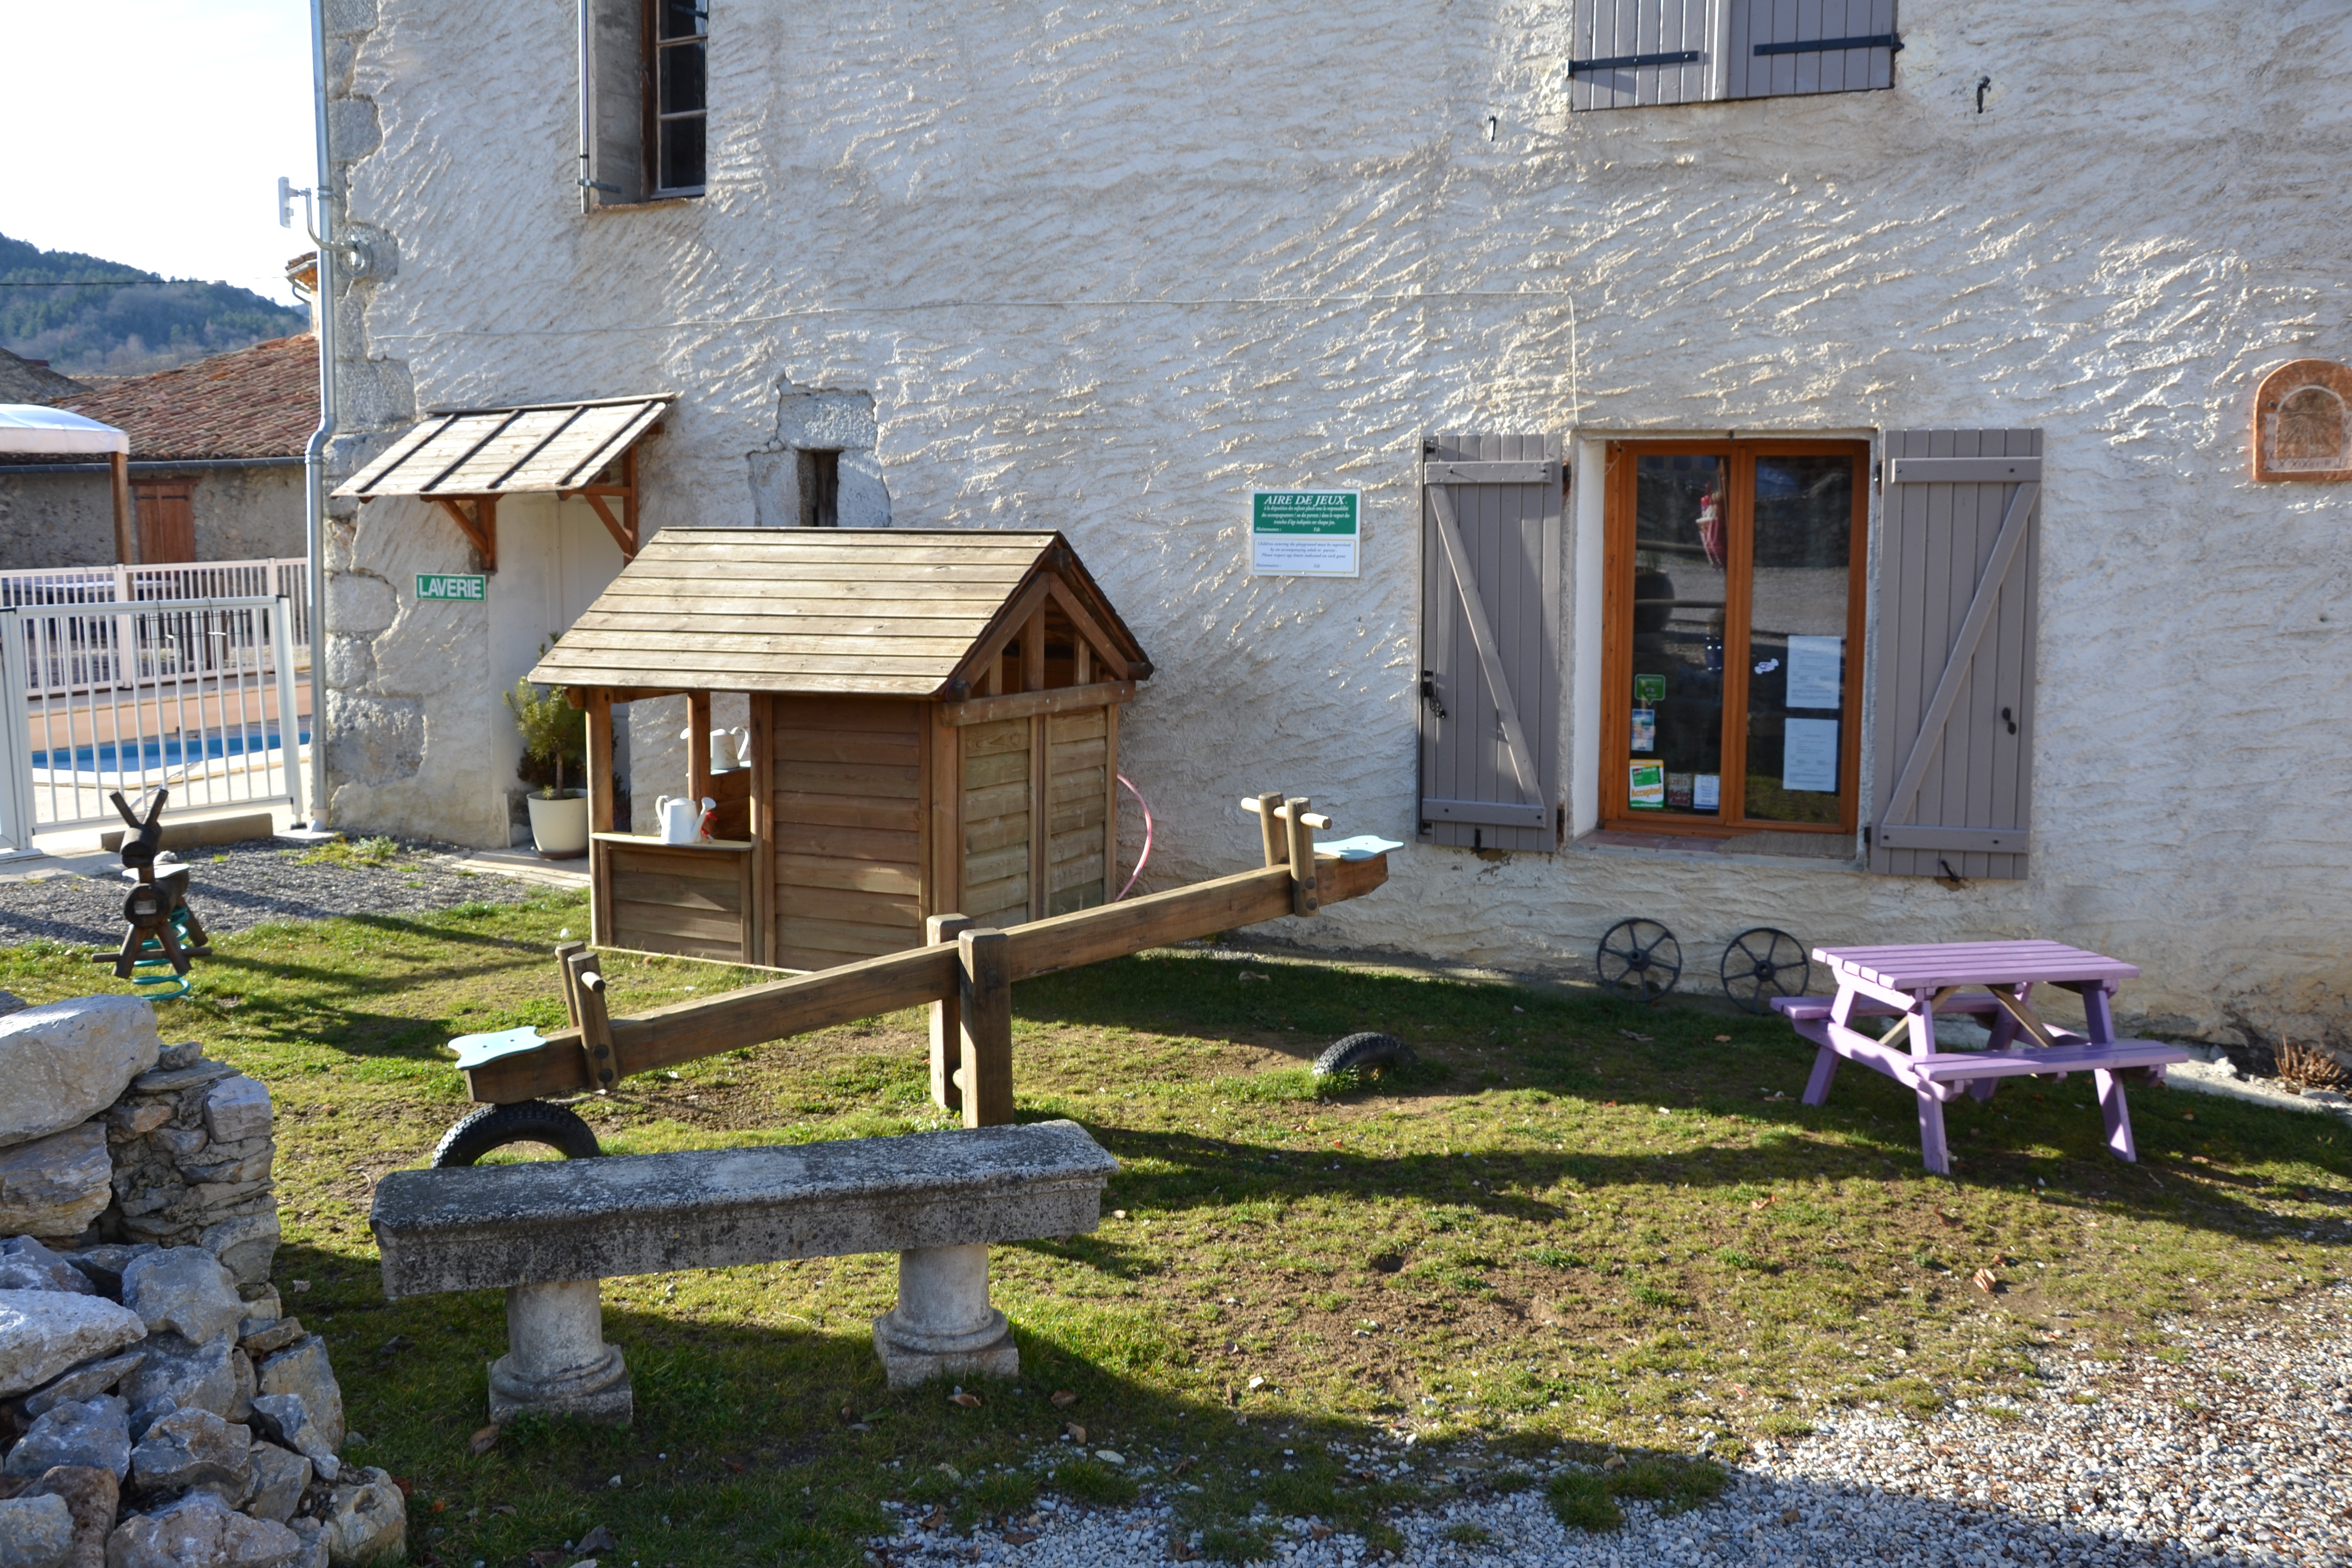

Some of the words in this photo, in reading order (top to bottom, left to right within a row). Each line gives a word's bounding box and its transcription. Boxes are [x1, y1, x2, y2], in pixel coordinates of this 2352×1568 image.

[1263, 495, 1293, 505] AIRE
[1295, 495, 1314, 505] DE
[1312, 495, 1346, 507] JEUX
[419, 577, 482, 598] LAVERIE
[1631, 785, 1662, 799] Accepted
